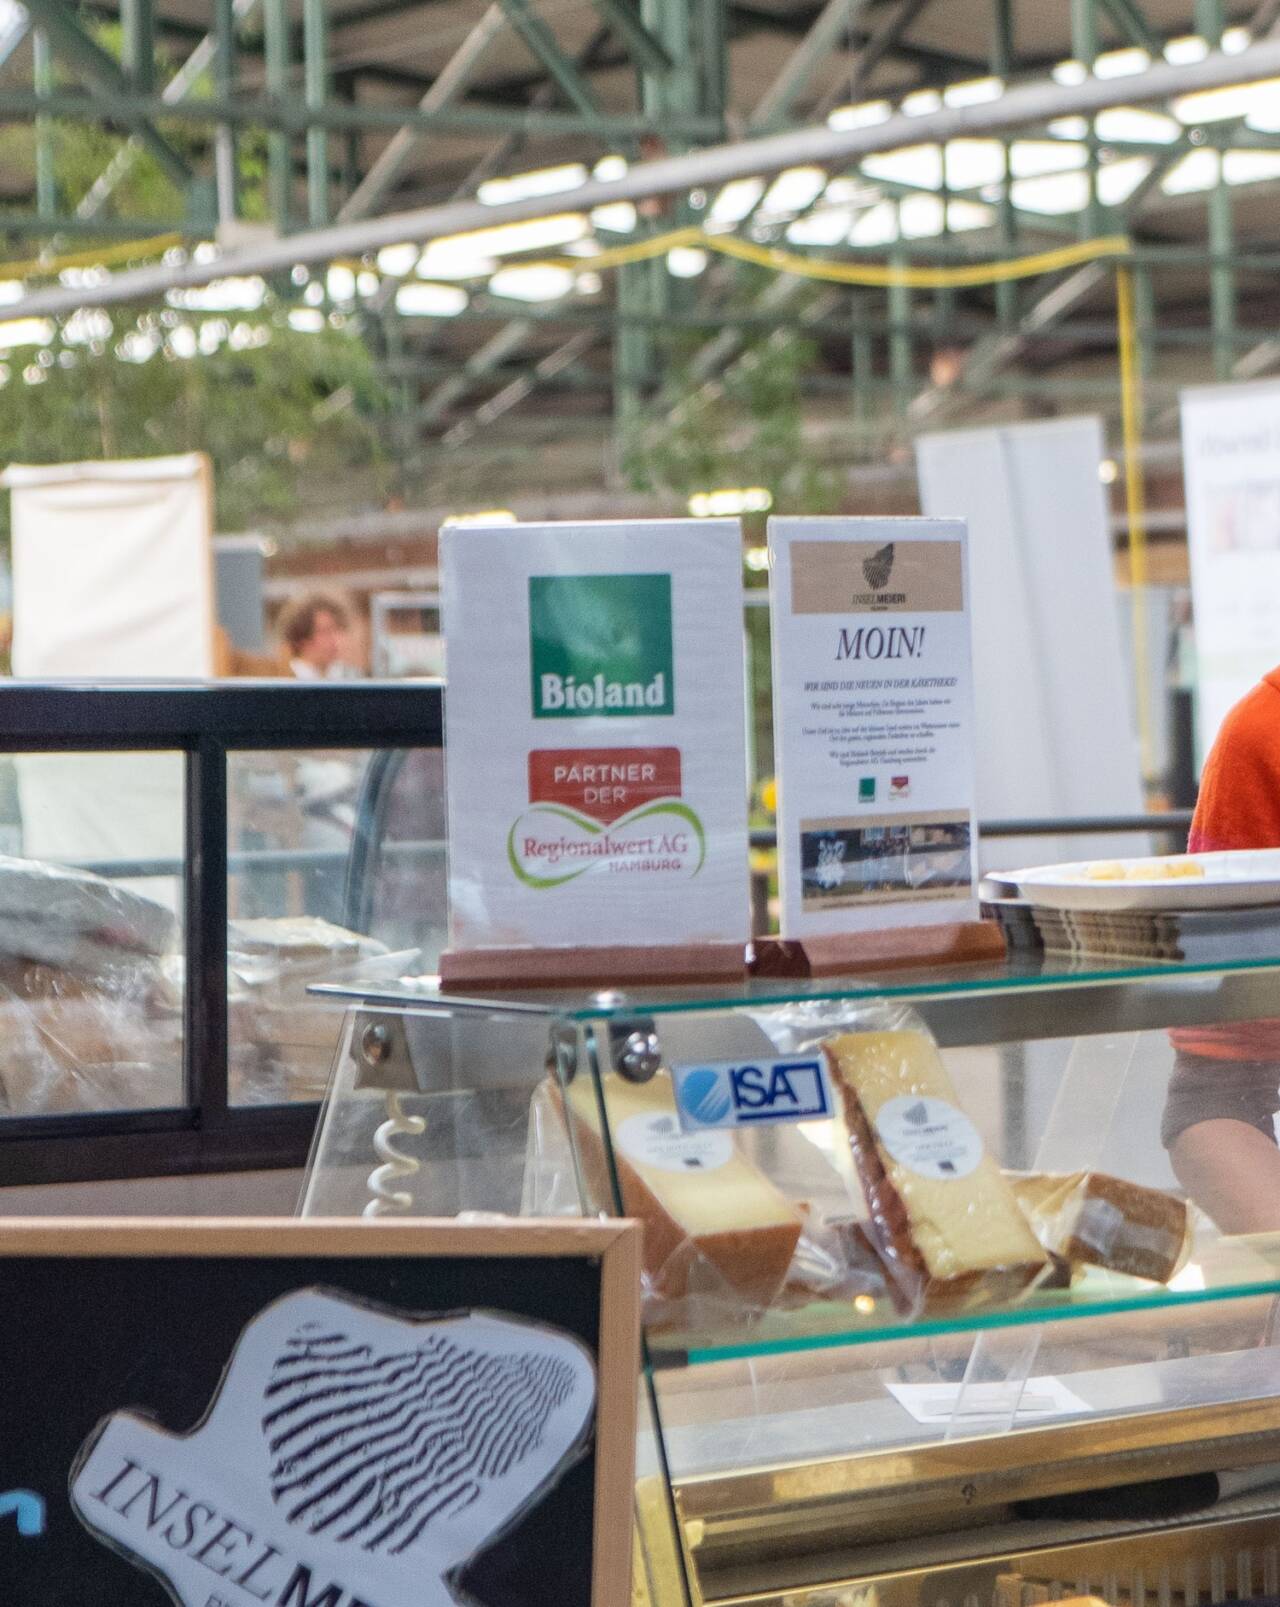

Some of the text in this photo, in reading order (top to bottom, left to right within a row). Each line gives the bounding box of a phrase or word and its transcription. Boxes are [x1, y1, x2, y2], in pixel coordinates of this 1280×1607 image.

[834, 626, 925, 661] MOIN!
[540, 672, 665, 710] Bioland
[553, 763, 656, 784] PARTNER
[583, 785, 627, 805] DER
[523, 831, 688, 864] Regionalwert AG
[609, 857, 682, 874] HAMBURG
[729, 1065, 800, 1111] ISA
[90, 1456, 372, 1607] INSELM
